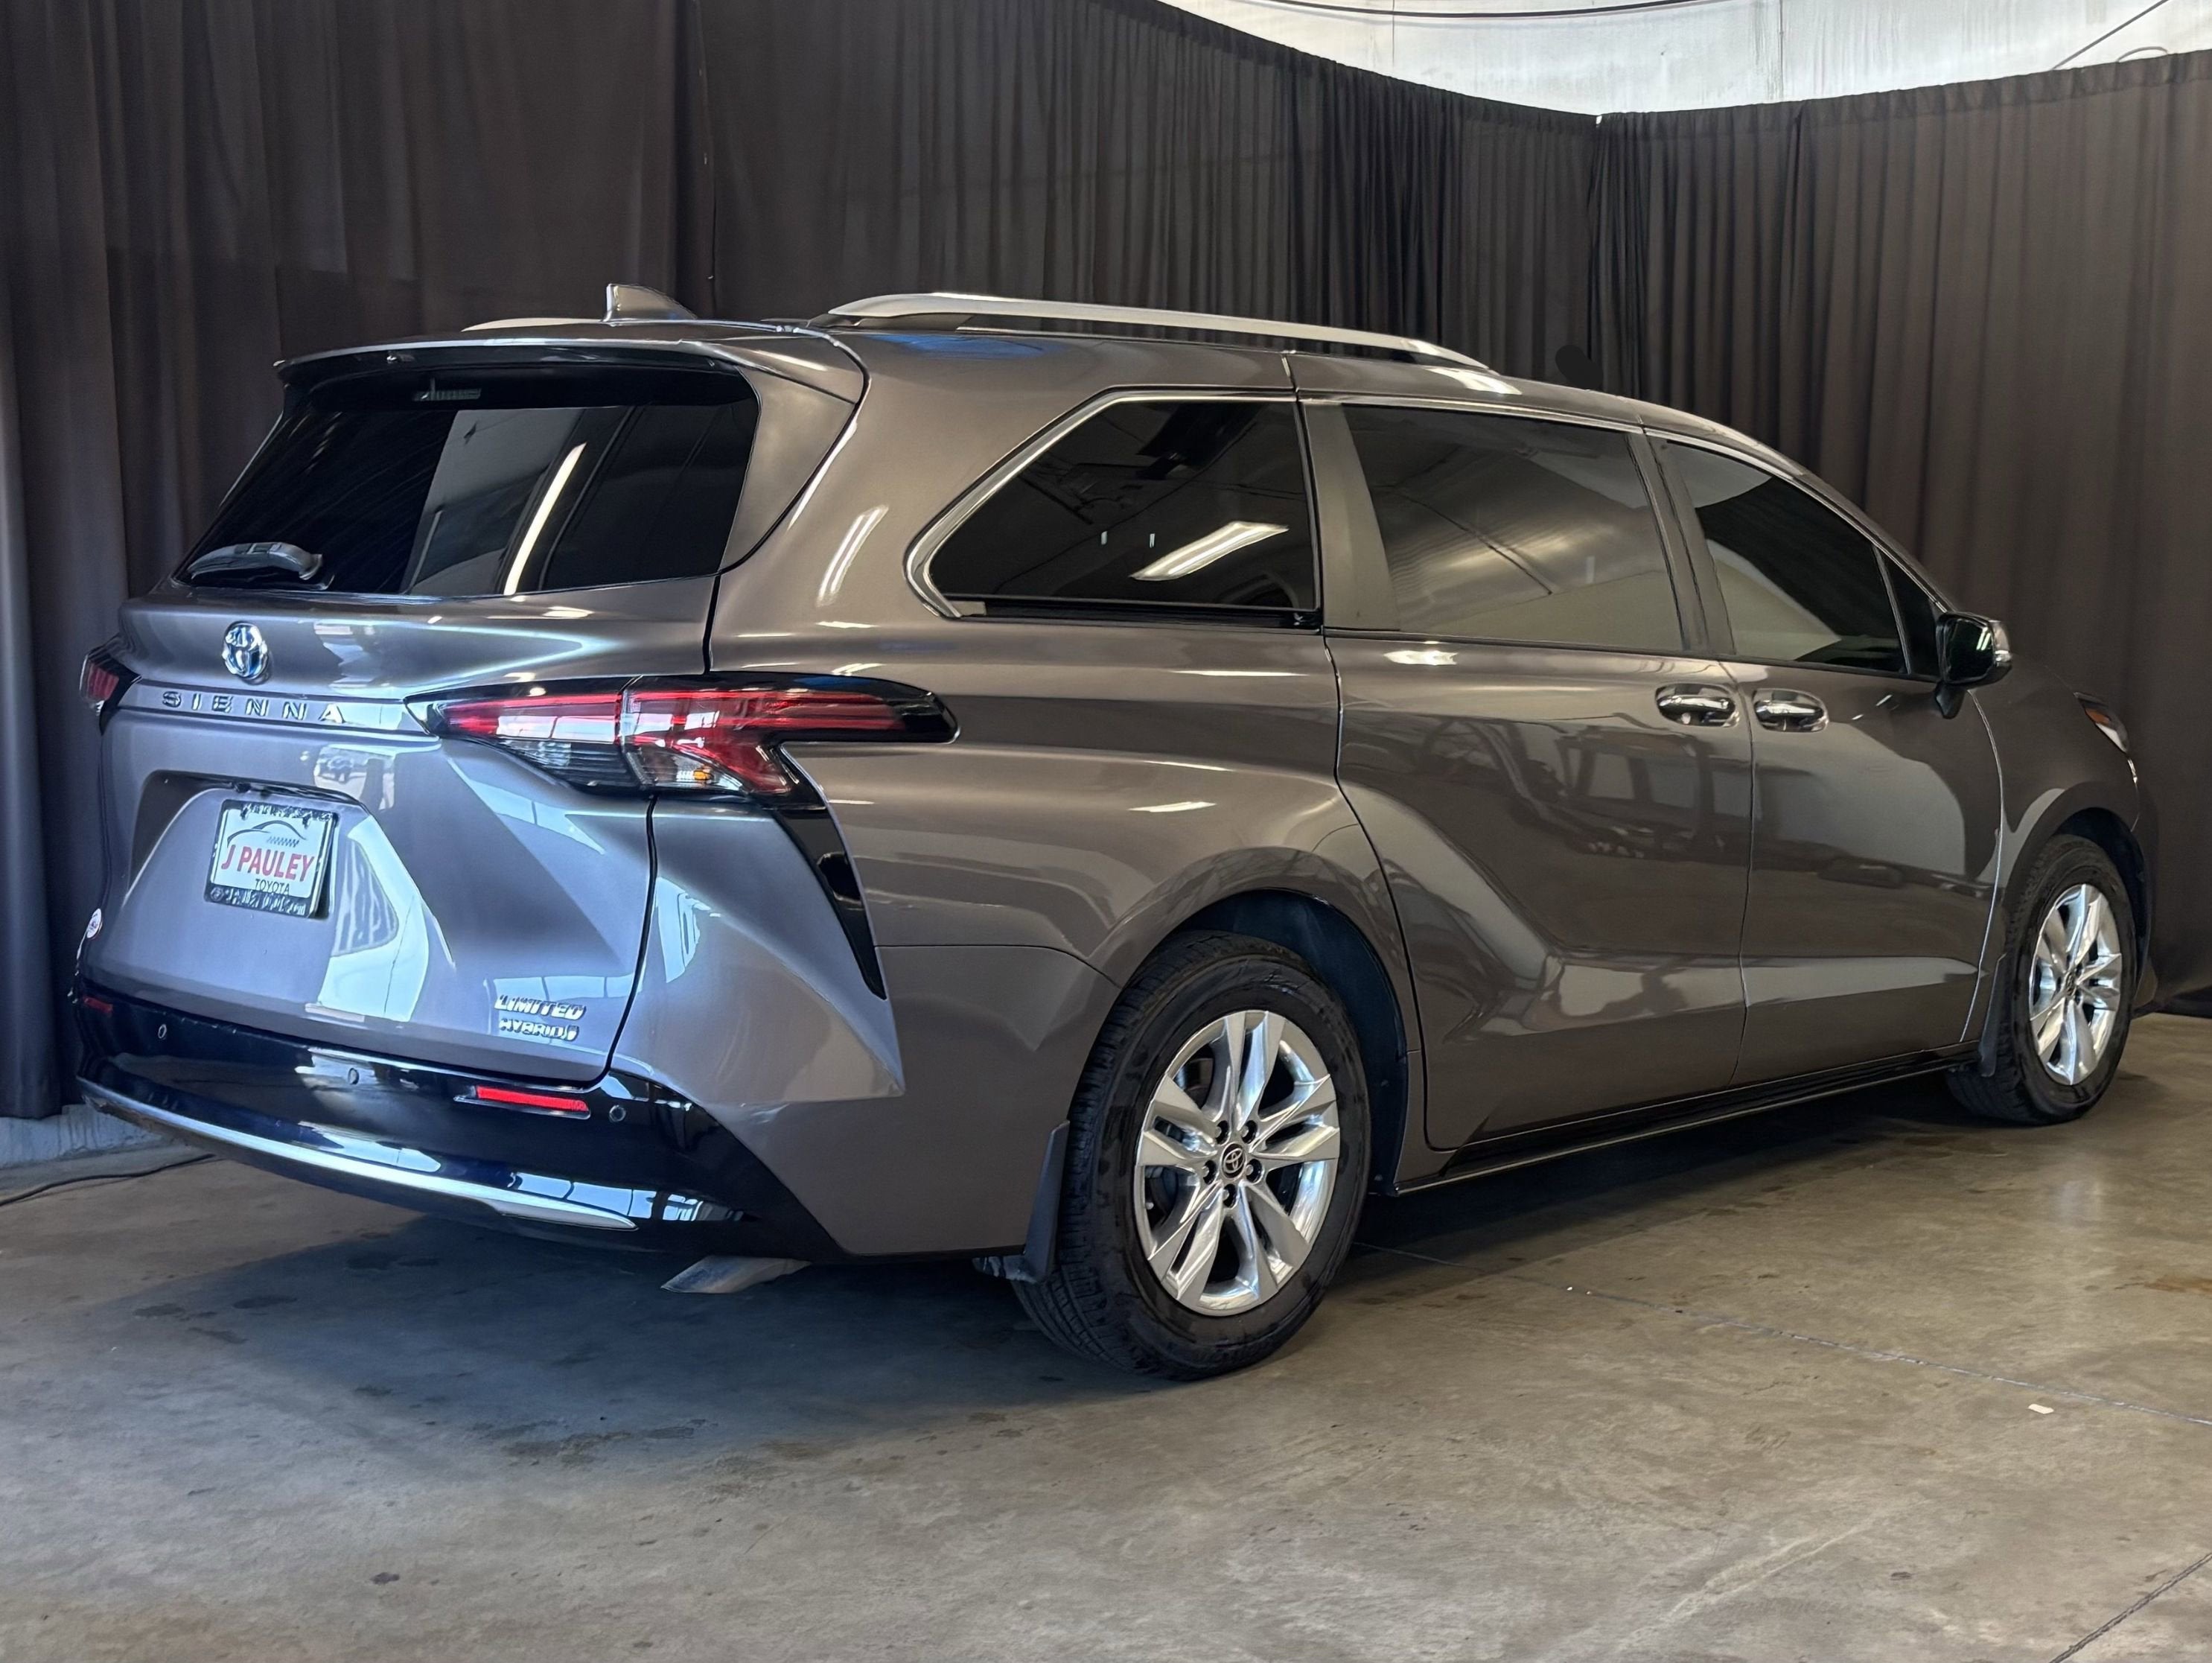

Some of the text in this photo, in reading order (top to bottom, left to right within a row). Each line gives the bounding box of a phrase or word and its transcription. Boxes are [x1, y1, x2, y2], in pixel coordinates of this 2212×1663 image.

[162, 691, 345, 724] SIENNA
[220, 844, 315, 882] J PAULEY
[255, 878, 290, 894] TOYOTA
[494, 994, 587, 1020] LIMITED
[499, 1018, 579, 1041] HYBRID
